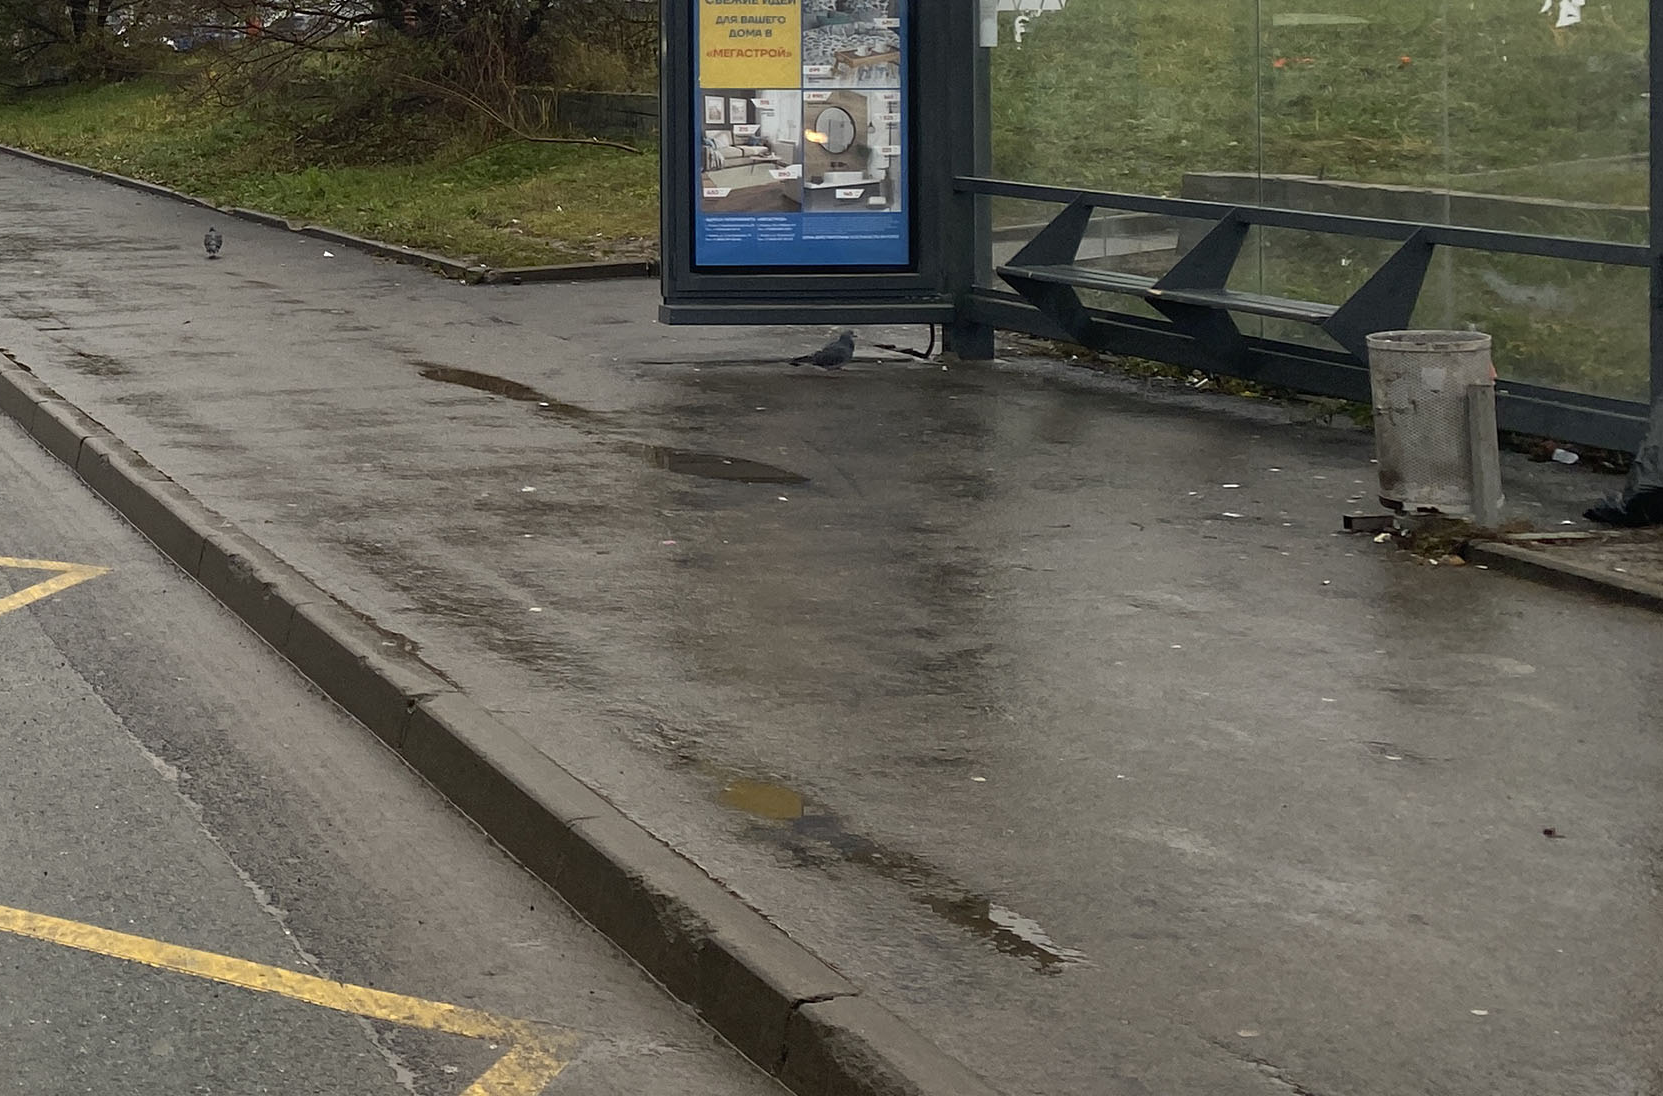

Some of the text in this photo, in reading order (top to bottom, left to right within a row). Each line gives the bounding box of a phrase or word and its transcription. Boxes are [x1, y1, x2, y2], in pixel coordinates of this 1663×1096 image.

[715, 15, 786, 25] ДЛЯ ВАШЕГО
[728, 29, 773, 38] ДОМА В
[706, 46, 793, 58] «МЕГАСТРОЙ»
